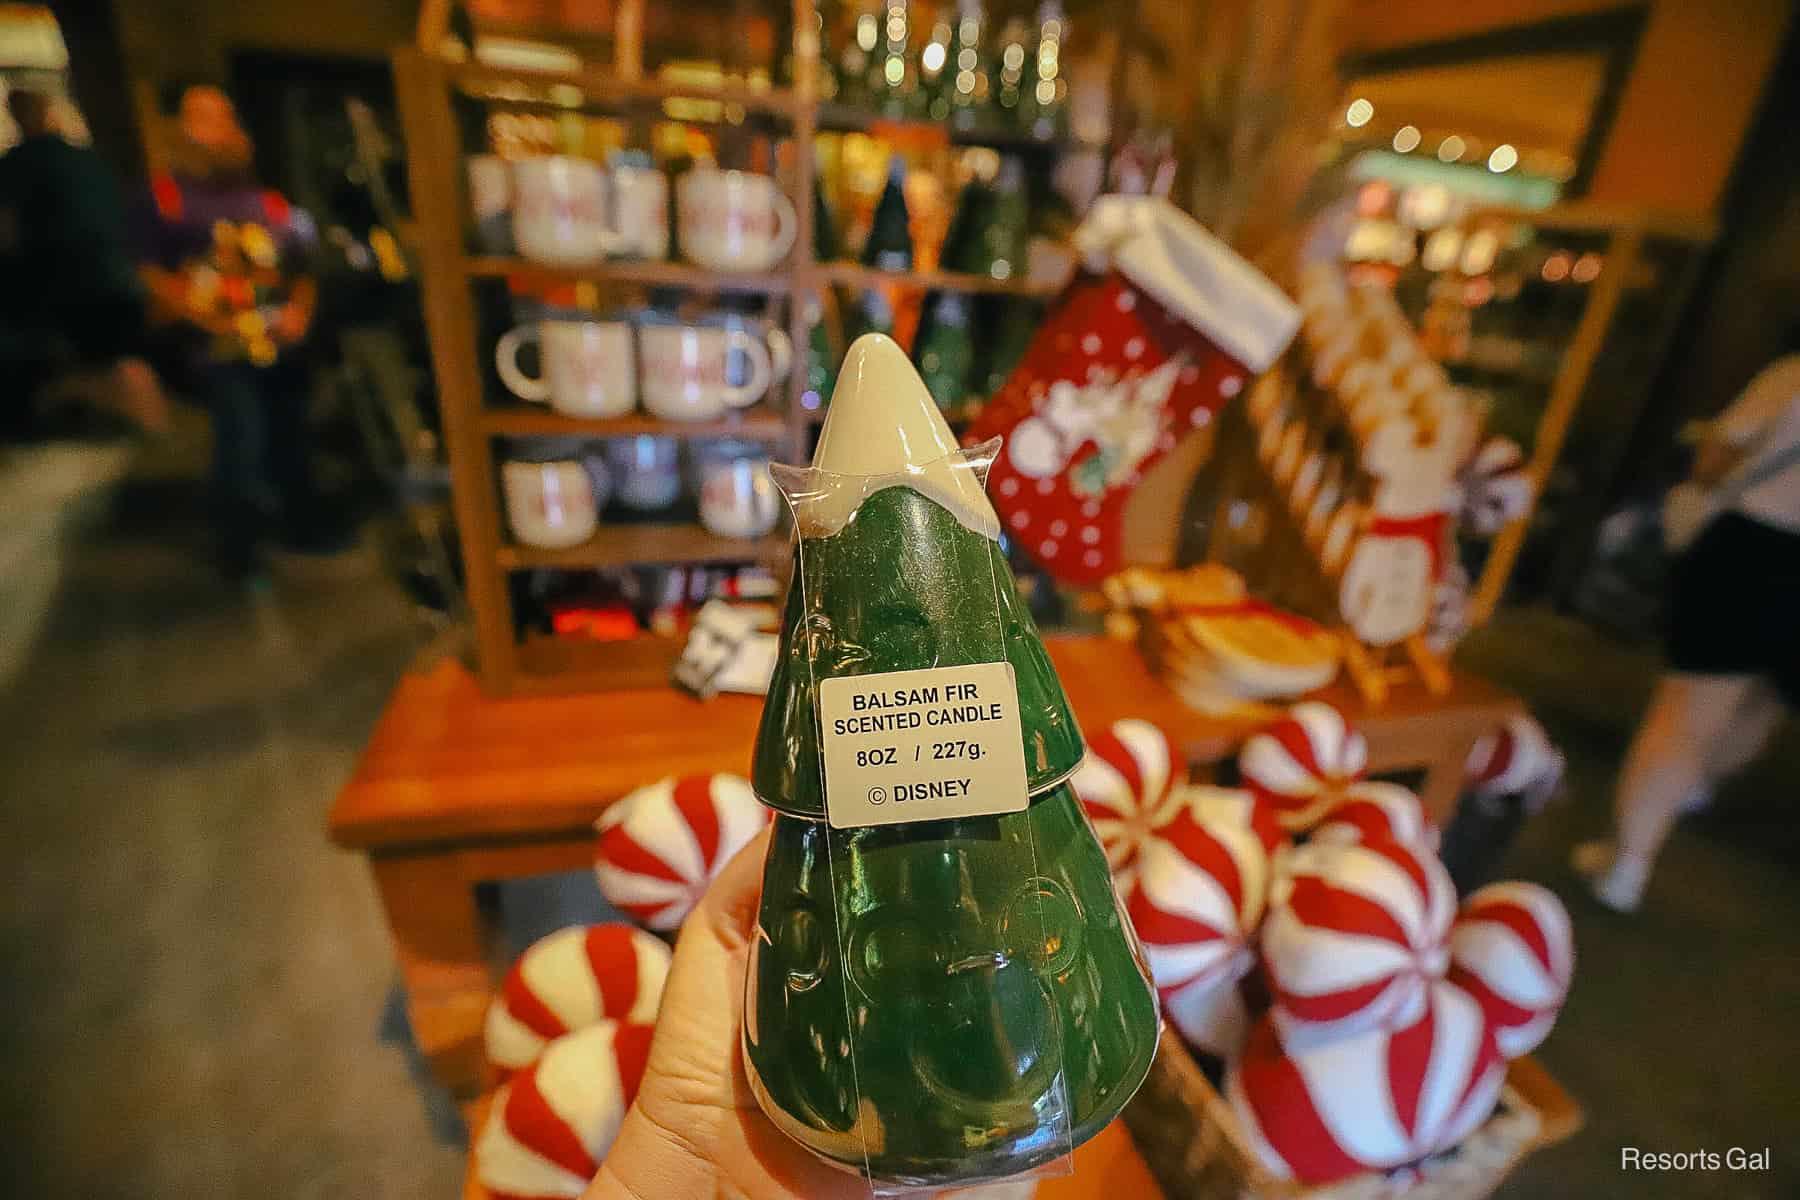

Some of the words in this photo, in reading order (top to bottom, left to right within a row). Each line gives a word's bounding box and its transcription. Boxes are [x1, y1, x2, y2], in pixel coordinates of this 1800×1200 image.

[852, 687, 938, 711] BALSAM
[945, 683, 979, 702] FIR
[834, 711, 921, 735] SCENTED
[926, 703, 1003, 726] CANDLE
[856, 747, 897, 767] 8OZ
[914, 745, 920, 761] /
[932, 741, 986, 760] 227g.
[893, 778, 972, 802] DISNEY
